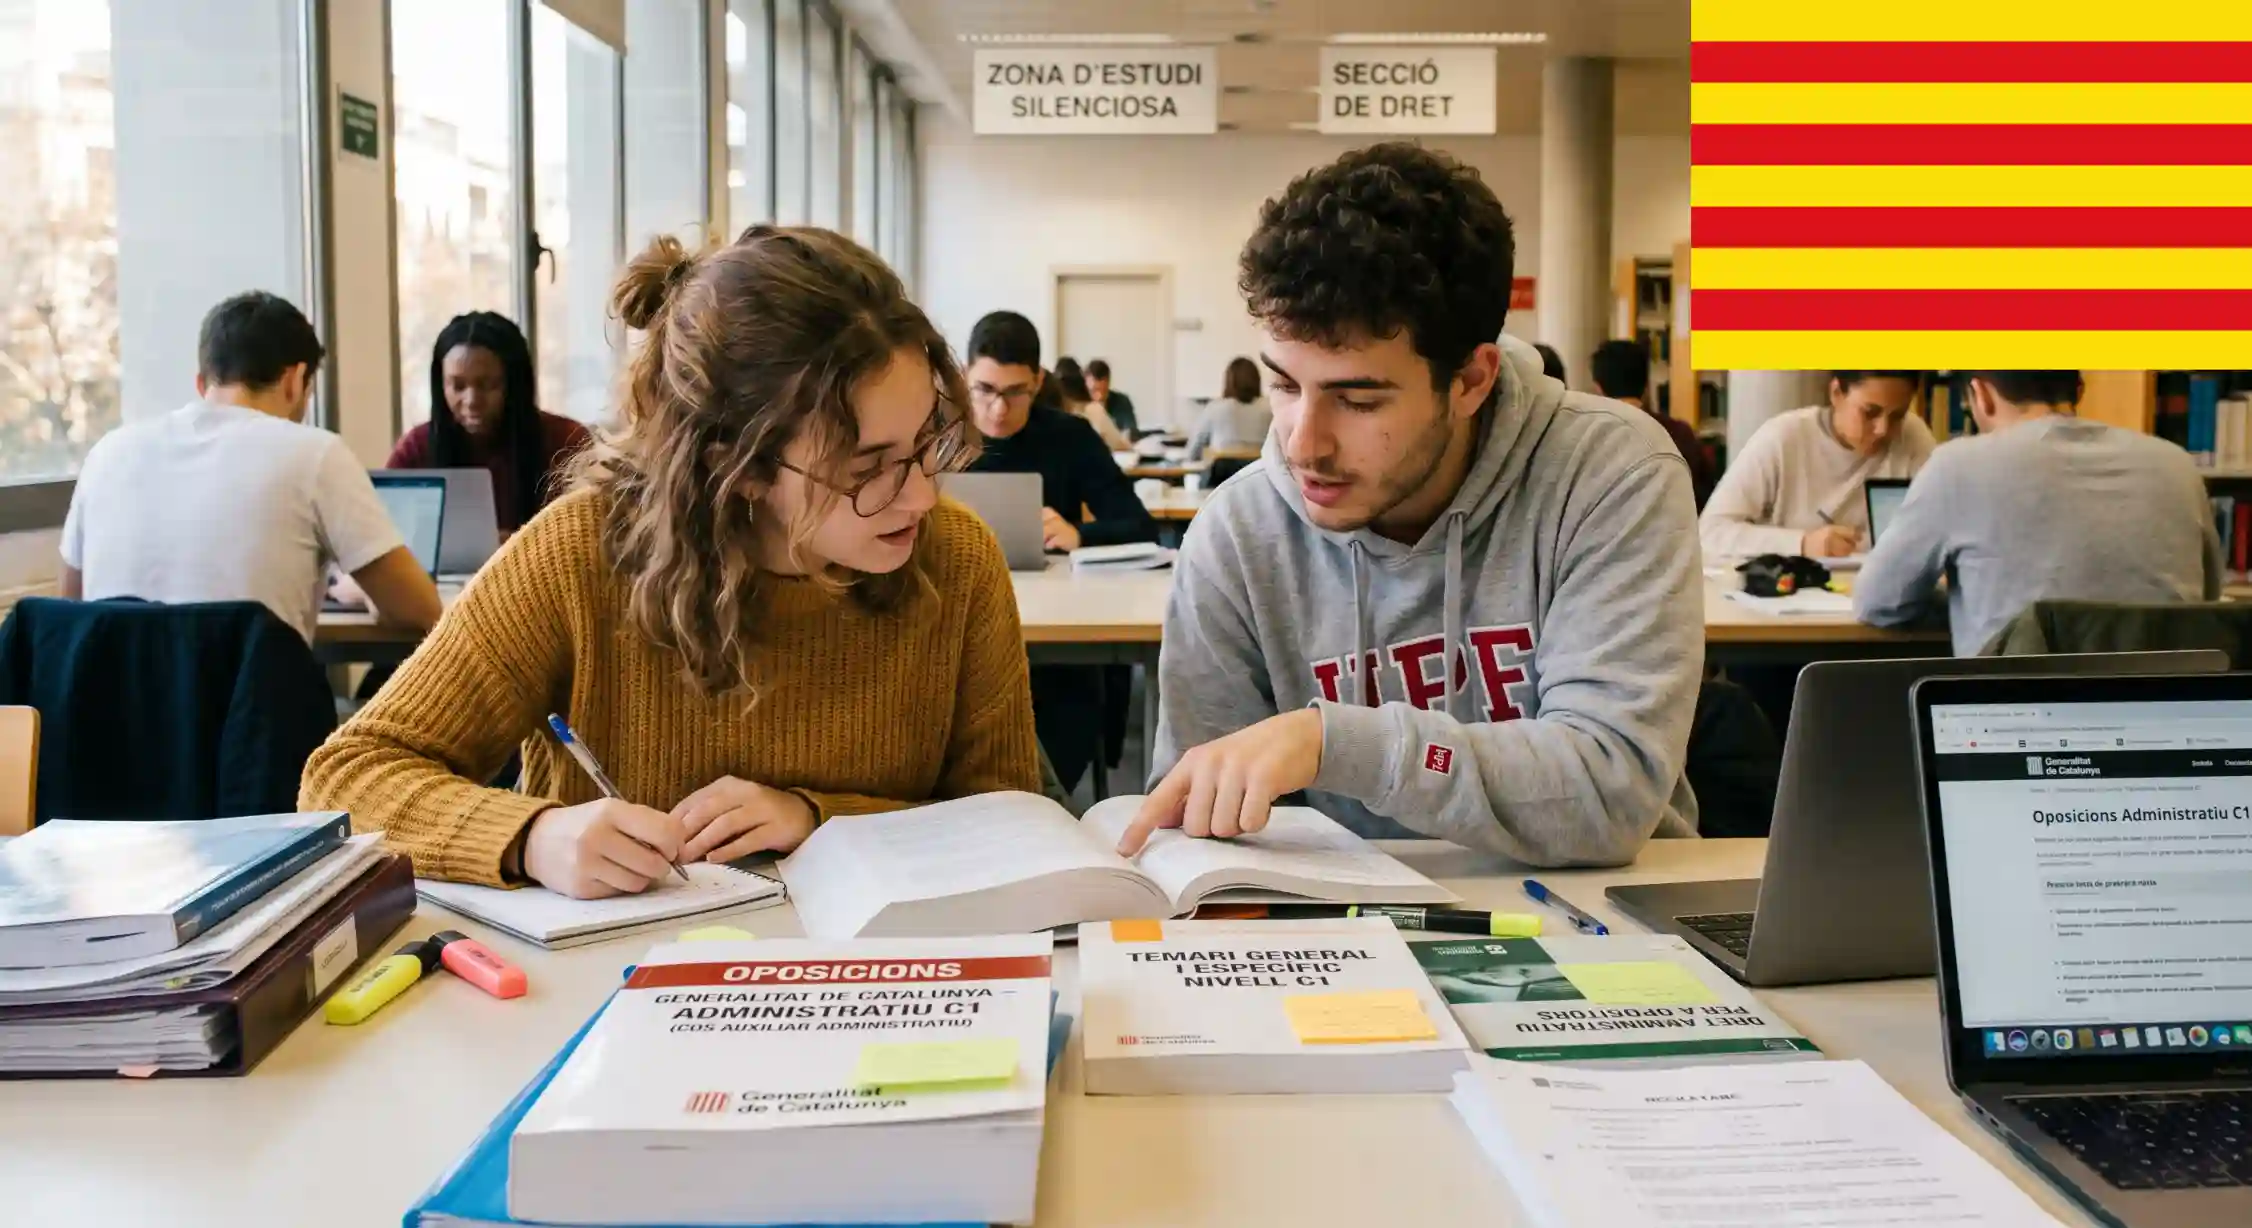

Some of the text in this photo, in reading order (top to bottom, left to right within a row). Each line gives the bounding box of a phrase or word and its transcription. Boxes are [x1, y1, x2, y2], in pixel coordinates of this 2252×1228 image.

[987, 63, 1202, 86] ZONA D'ESTUDI
[1333, 57, 1440, 85] SECCIÓ
[1011, 96, 1178, 118] SILENCIOSA
[1334, 95, 1454, 117] DE DRET
[2045, 756, 2091, 766] Generalitat
[2046, 766, 2101, 776] de Catalunya
[2033, 805, 2250, 826] Oposicions Administratiu C1
[1126, 949, 1377, 962] TEMARI GENERAL
[722, 962, 963, 982] OPOSICIONS
[1175, 961, 1342, 974] I ESPECÍFIC
[1183, 975, 1330, 988] NIVELL C1
[654, 991, 810, 1004] GENERALITAT
[819, 991, 852, 1001] DE
[857, 987, 994, 1001] CATALUNYA
[671, 1001, 981, 1020] ADMINISTRATIU C1
[1677, 1006, 1695, 1016] A
[1699, 1005, 1751, 1016] PER
[669, 1018, 973, 1034] (COS AUXILIAR ADMINISTRATIU)
[1707, 1016, 1766, 1027] DRET
[741, 1084, 883, 1102] Generalitat
[737, 1098, 908, 1114] de Catalunya
